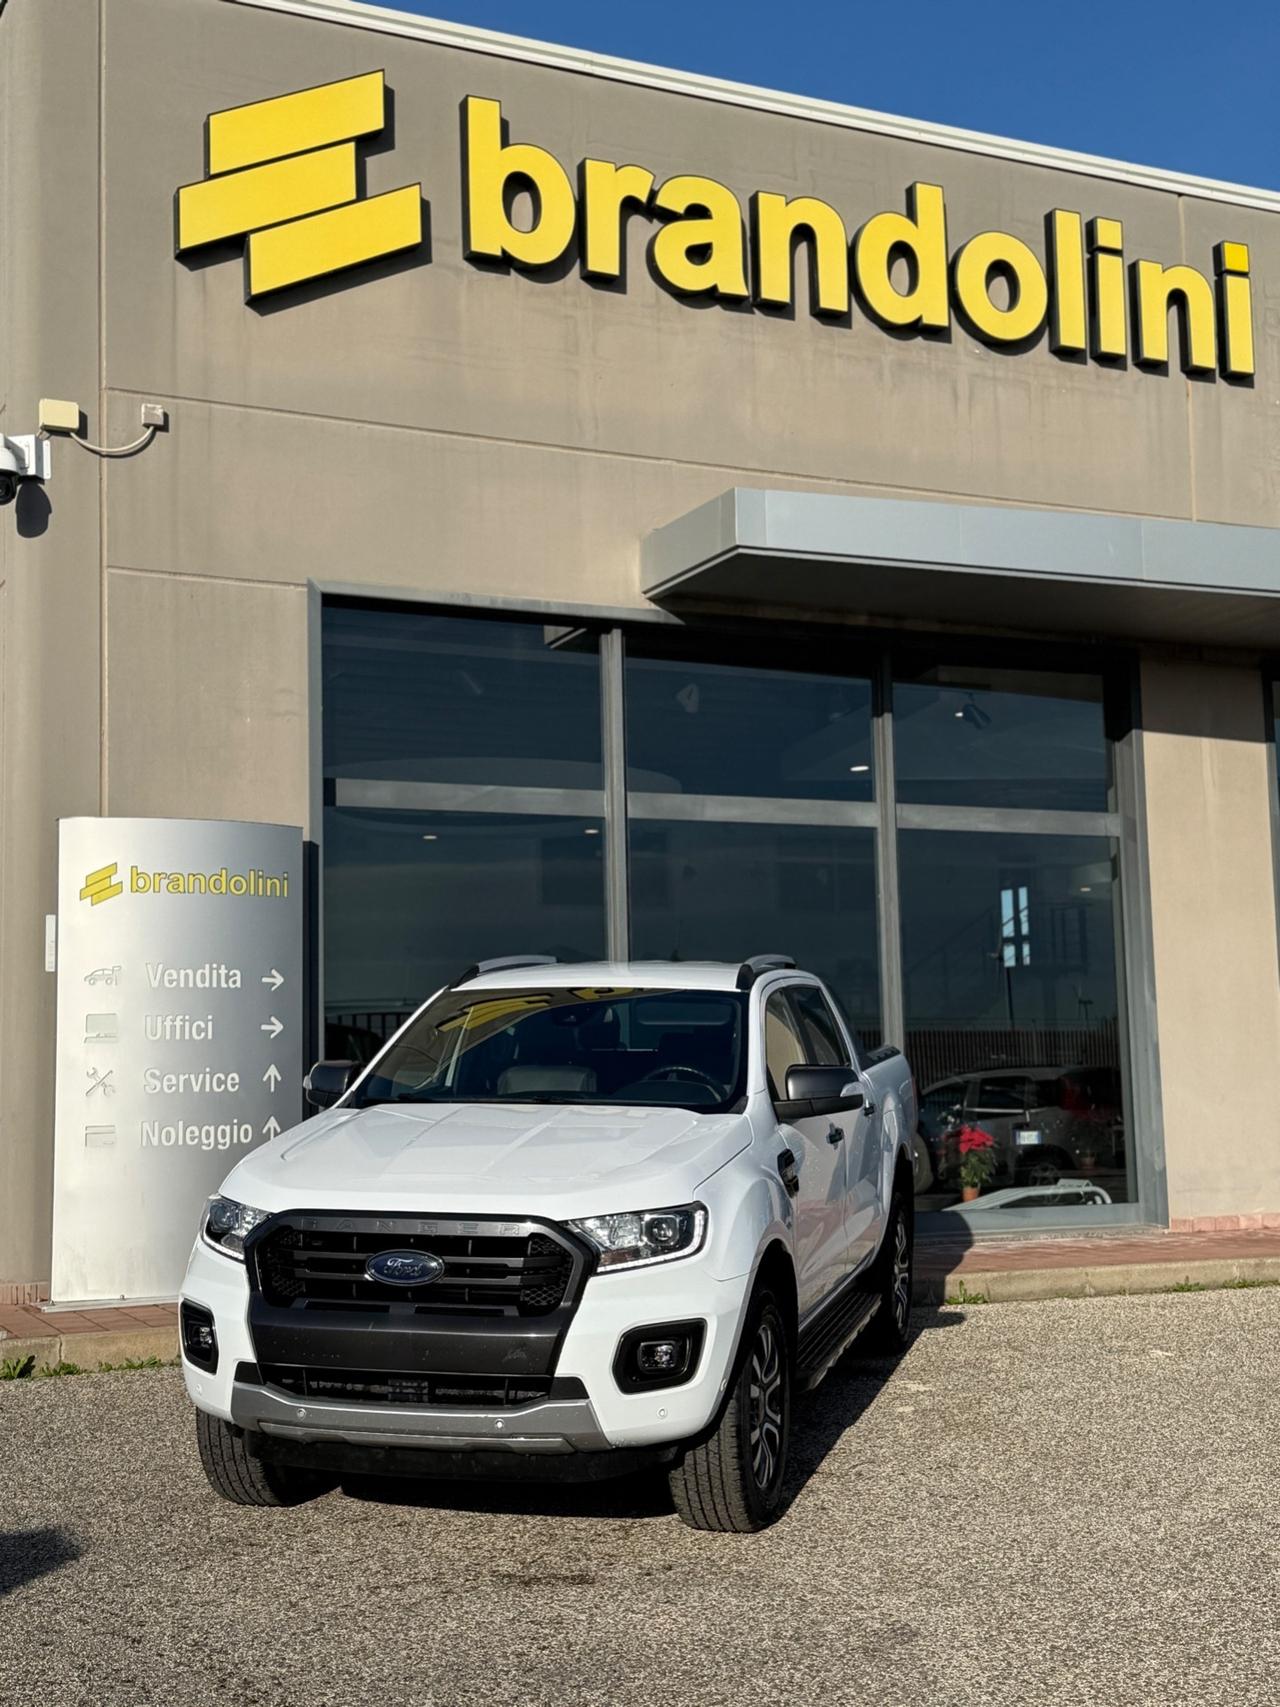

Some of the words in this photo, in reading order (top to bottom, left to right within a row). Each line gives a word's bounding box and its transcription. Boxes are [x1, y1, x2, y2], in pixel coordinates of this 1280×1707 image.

[463, 95, 1255, 378] brandolini
[129, 865, 289, 898] brandolini
[145, 963, 242, 989] Vendita
[144, 1014, 214, 1041] Uffici
[143, 1067, 240, 1094] Service
[140, 1119, 253, 1151] Noleggio
[383, 1257, 424, 1276] Ford
